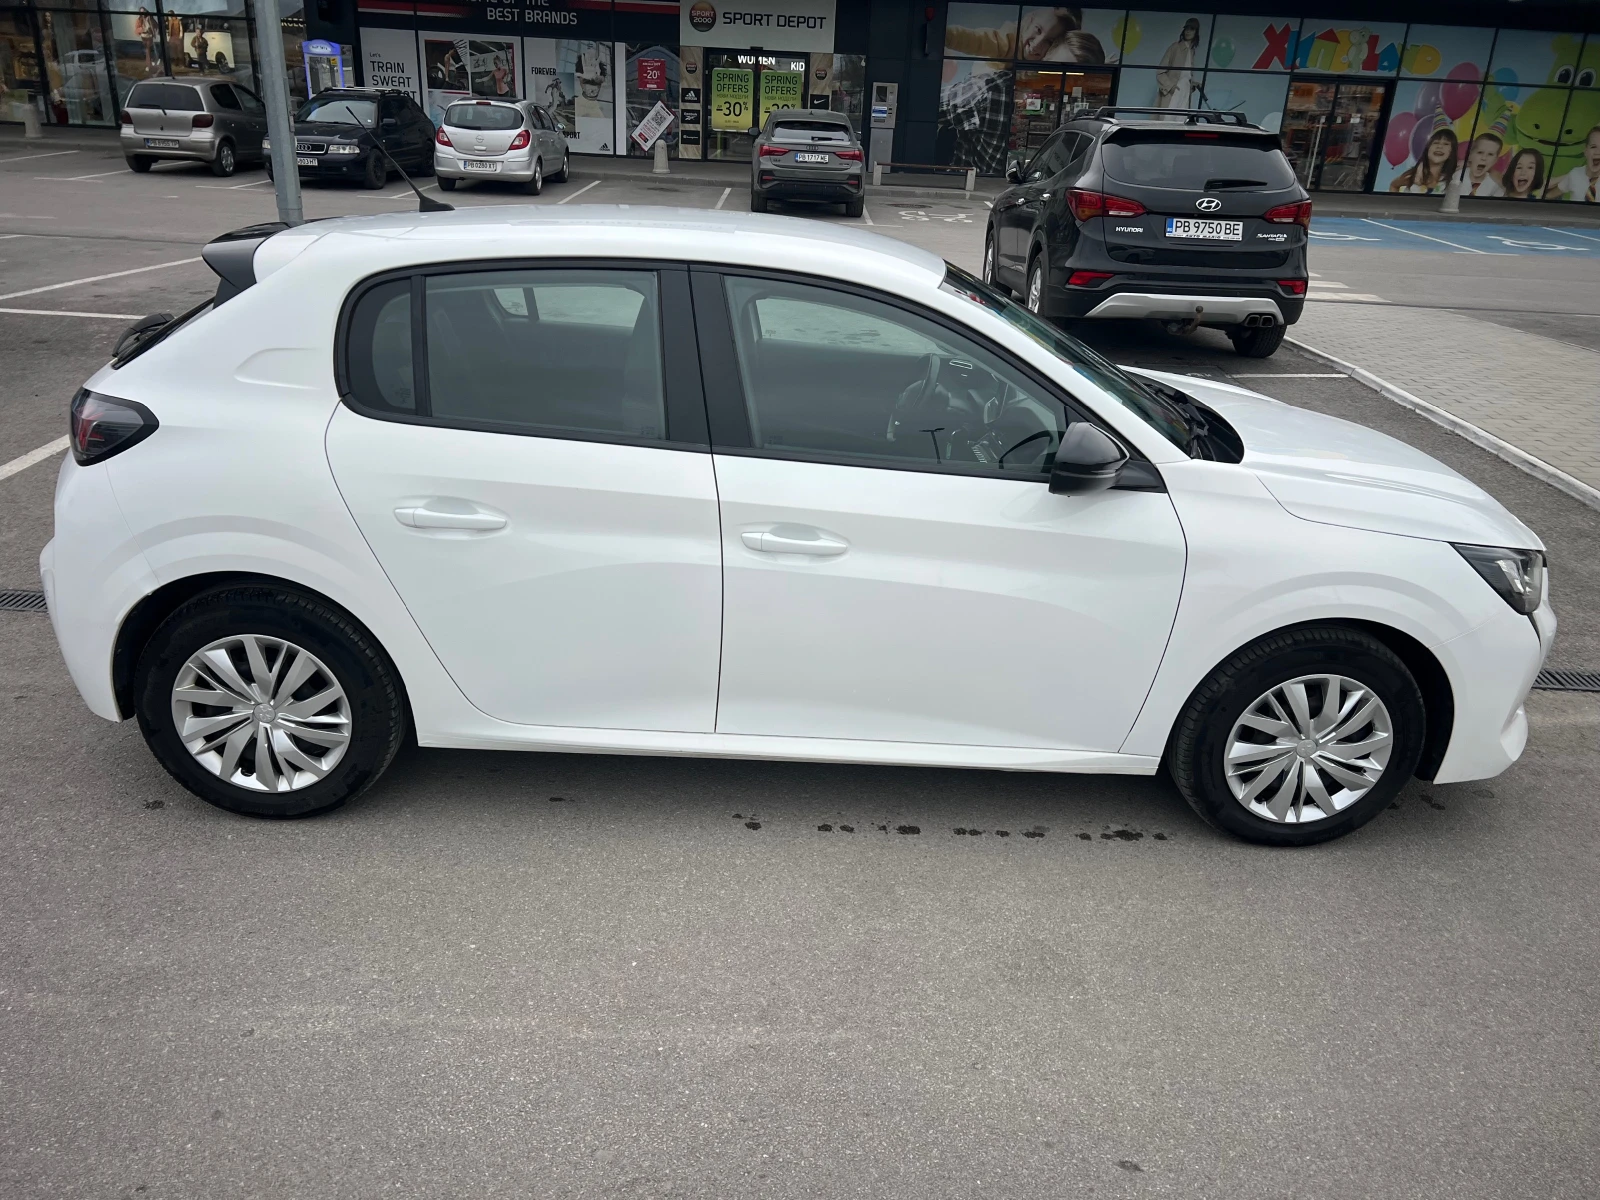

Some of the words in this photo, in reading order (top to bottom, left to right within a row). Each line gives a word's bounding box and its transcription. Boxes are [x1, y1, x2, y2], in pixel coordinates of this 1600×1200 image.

[487, 7, 520, 22] BEST
[525, 9, 578, 25] BRANDS
[722, 11, 773, 27] SPORT
[777, 14, 827, 30] DEPOT
[370, 60, 405, 73] TRAIN
[531, 66, 557, 76] FOREVER
[372, 75, 412, 88] SWEAT
[716, 72, 750, 84] SPRING
[764, 75, 798, 86] SPRING
[716, 83, 749, 93] OFFERS
[764, 85, 797, 96] OFFERS
[716, 101, 749, 117] -30%
[1175, 220, 1191, 233] PB
[1193, 221, 1223, 235] 9750
[1224, 223, 1241, 236] BE
